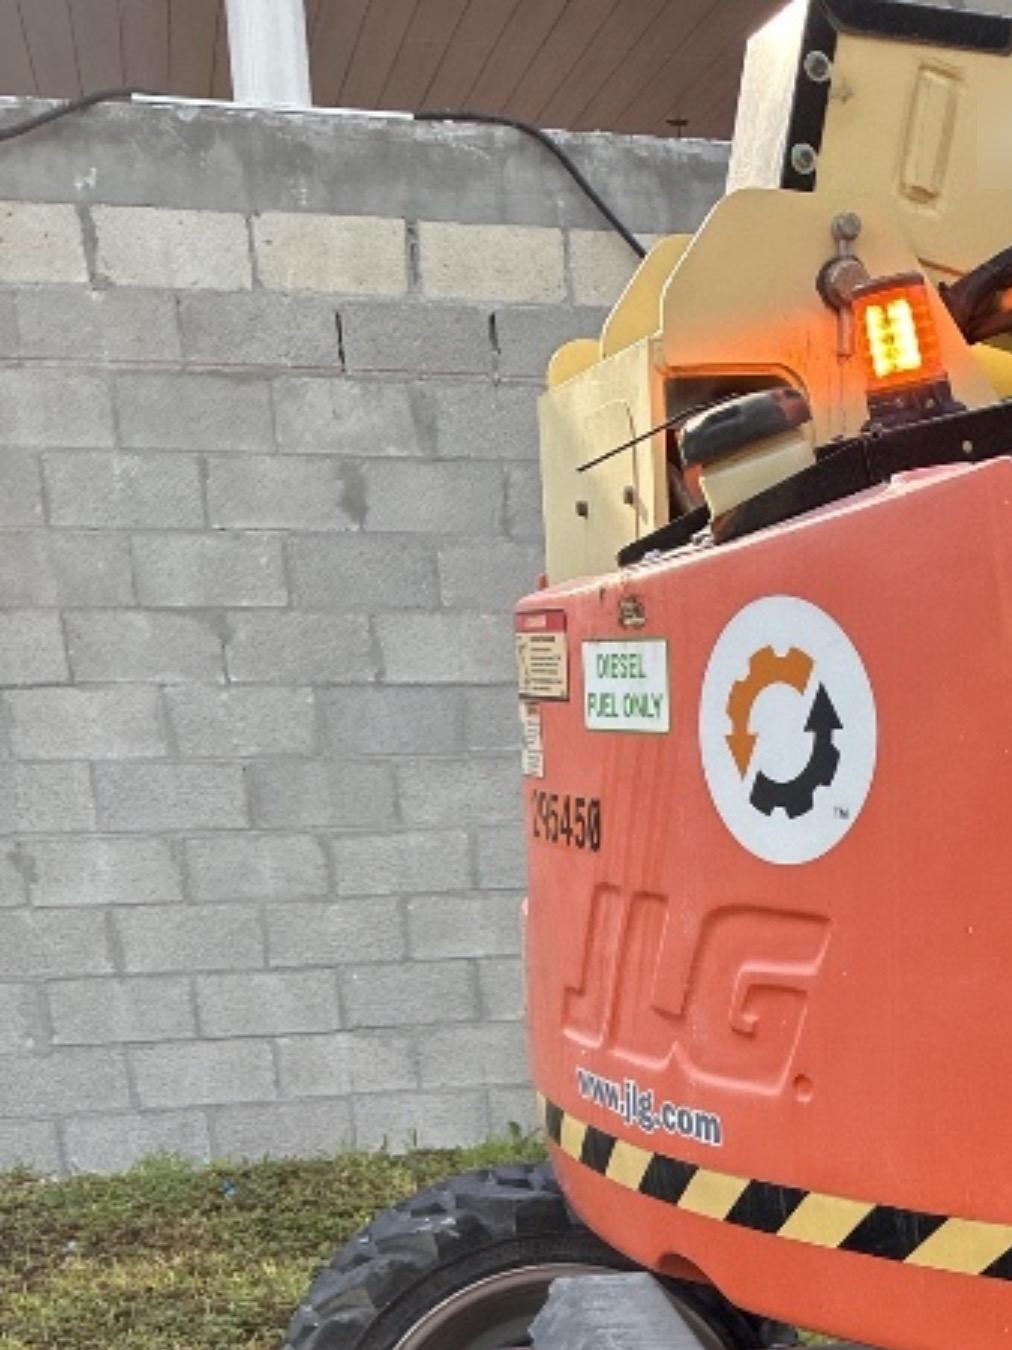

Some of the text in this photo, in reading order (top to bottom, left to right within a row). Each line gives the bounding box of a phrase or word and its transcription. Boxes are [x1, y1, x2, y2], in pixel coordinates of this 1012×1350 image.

[596, 652, 647, 680] DIESEL
[587, 691, 664, 719] FUEL ONLY
[562, 881, 833, 1096] JLG
[575, 1066, 723, 1146] www.jlg.com
